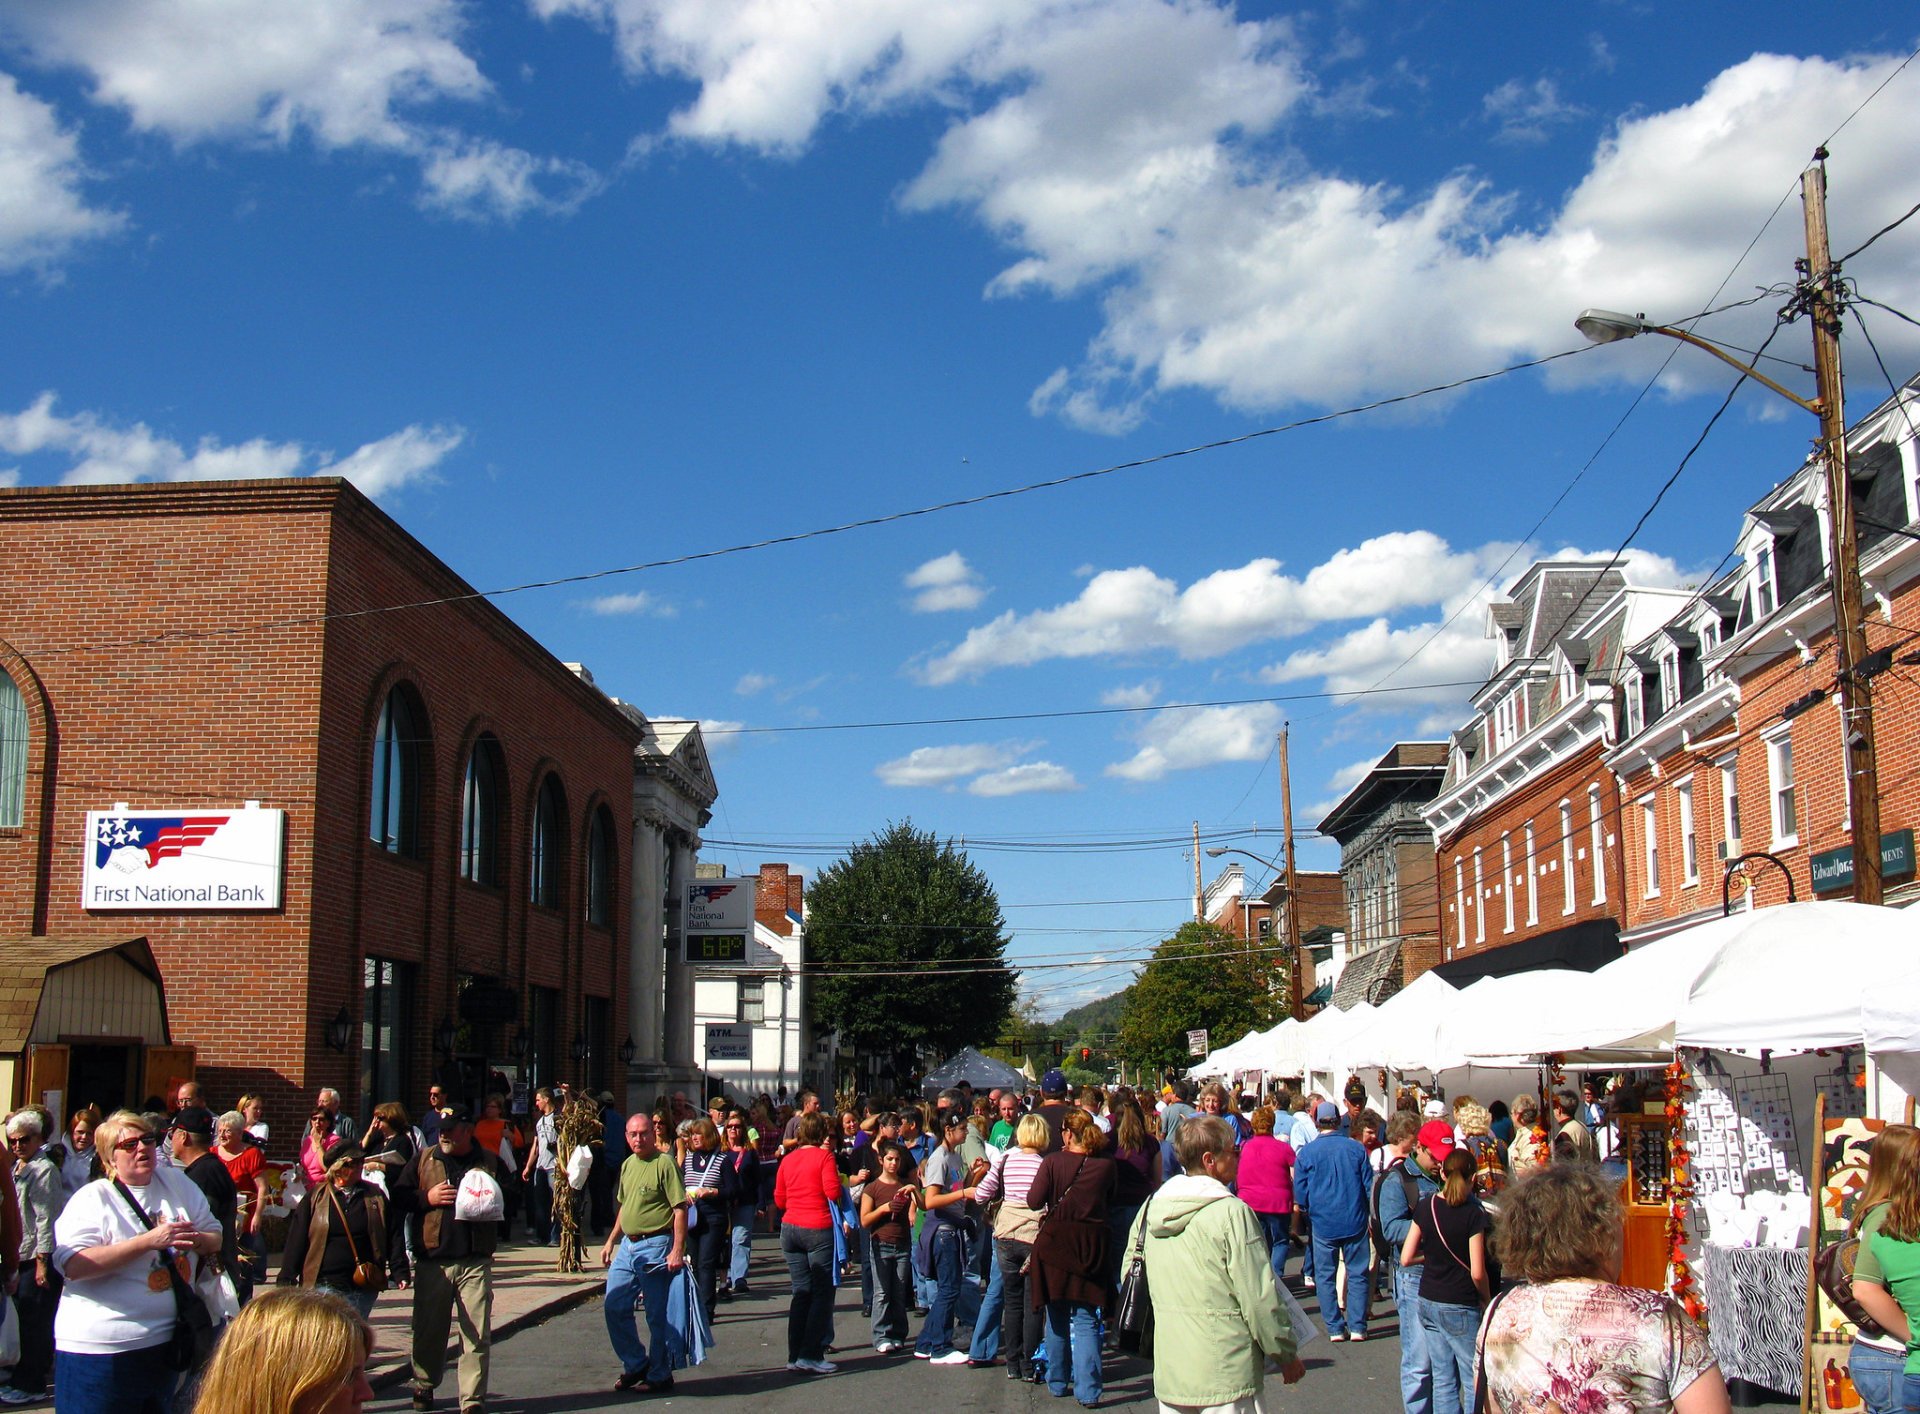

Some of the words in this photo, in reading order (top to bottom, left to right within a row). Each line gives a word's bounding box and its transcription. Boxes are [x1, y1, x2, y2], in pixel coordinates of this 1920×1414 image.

[94, 885, 129, 902] First
[135, 884, 211, 902] National
[217, 884, 264, 902] Bank
[689, 904, 706, 912] First
[689, 911, 724, 920] National
[689, 920, 711, 928] Bank
[708, 1029, 731, 1037] ATM
